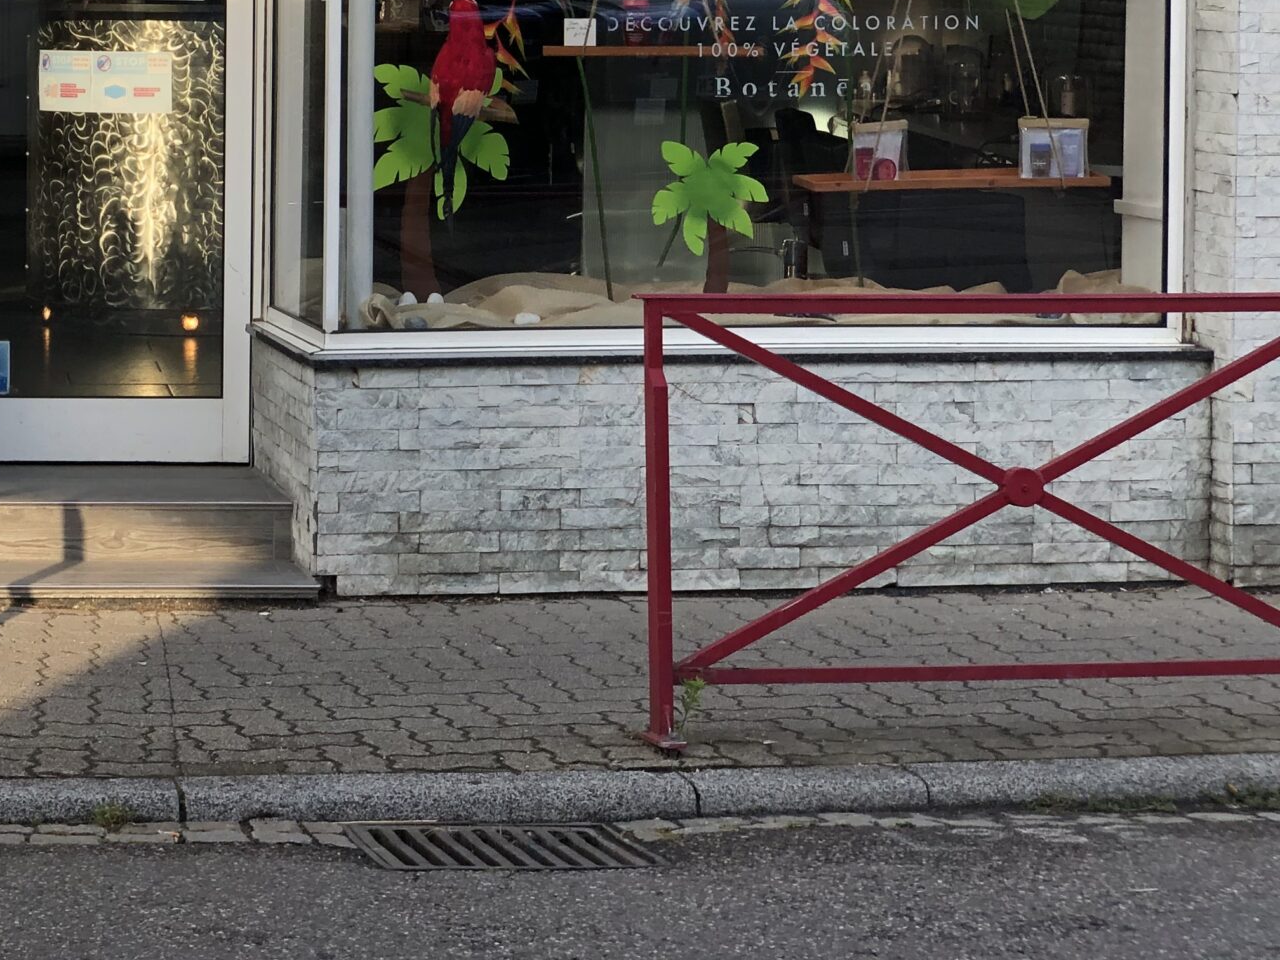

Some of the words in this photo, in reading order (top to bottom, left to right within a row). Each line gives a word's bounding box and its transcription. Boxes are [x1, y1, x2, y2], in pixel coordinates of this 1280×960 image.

[607, 13, 756, 32] DÉCOUVREZ
[772, 15, 798, 31] LA
[814, 15, 980, 31] COLORATION
[697, 42, 759, 57] 100%
[773, 38, 893, 57] VÉGÉTALE
